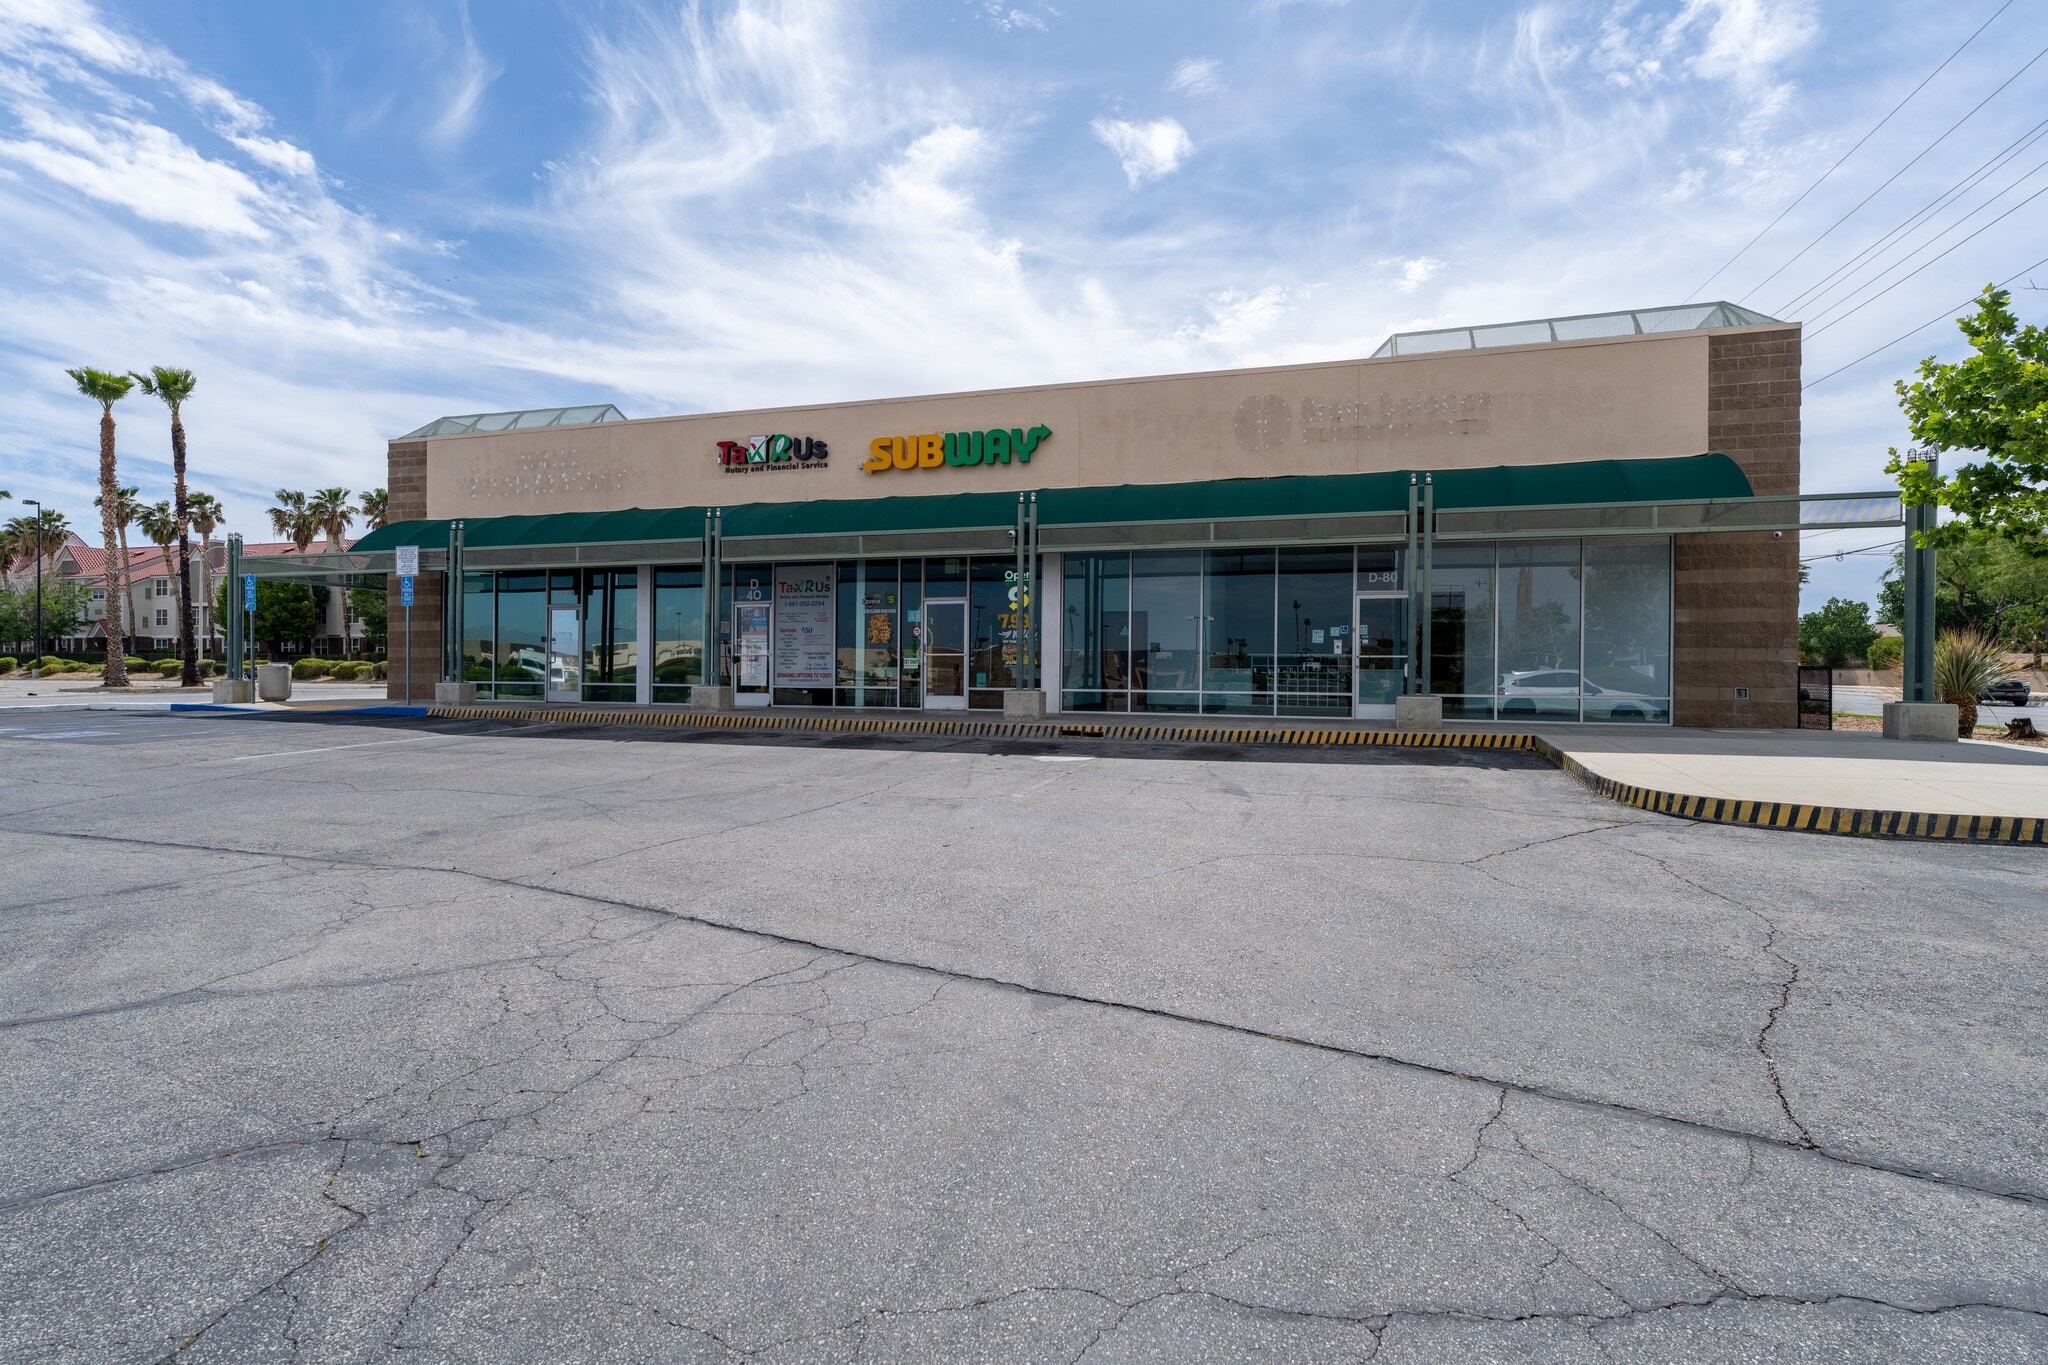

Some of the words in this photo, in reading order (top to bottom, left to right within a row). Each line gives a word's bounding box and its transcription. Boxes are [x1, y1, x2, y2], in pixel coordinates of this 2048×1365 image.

[863, 423, 1053, 475] SUBWAY
[725, 466, 749, 474] Notary
[751, 464, 764, 472] and
[766, 462, 799, 471] Financial
[801, 461, 828, 470] Service
[1368, 572, 1398, 583] D-80
[750, 579, 759, 590] D
[746, 590, 762, 600] 40
